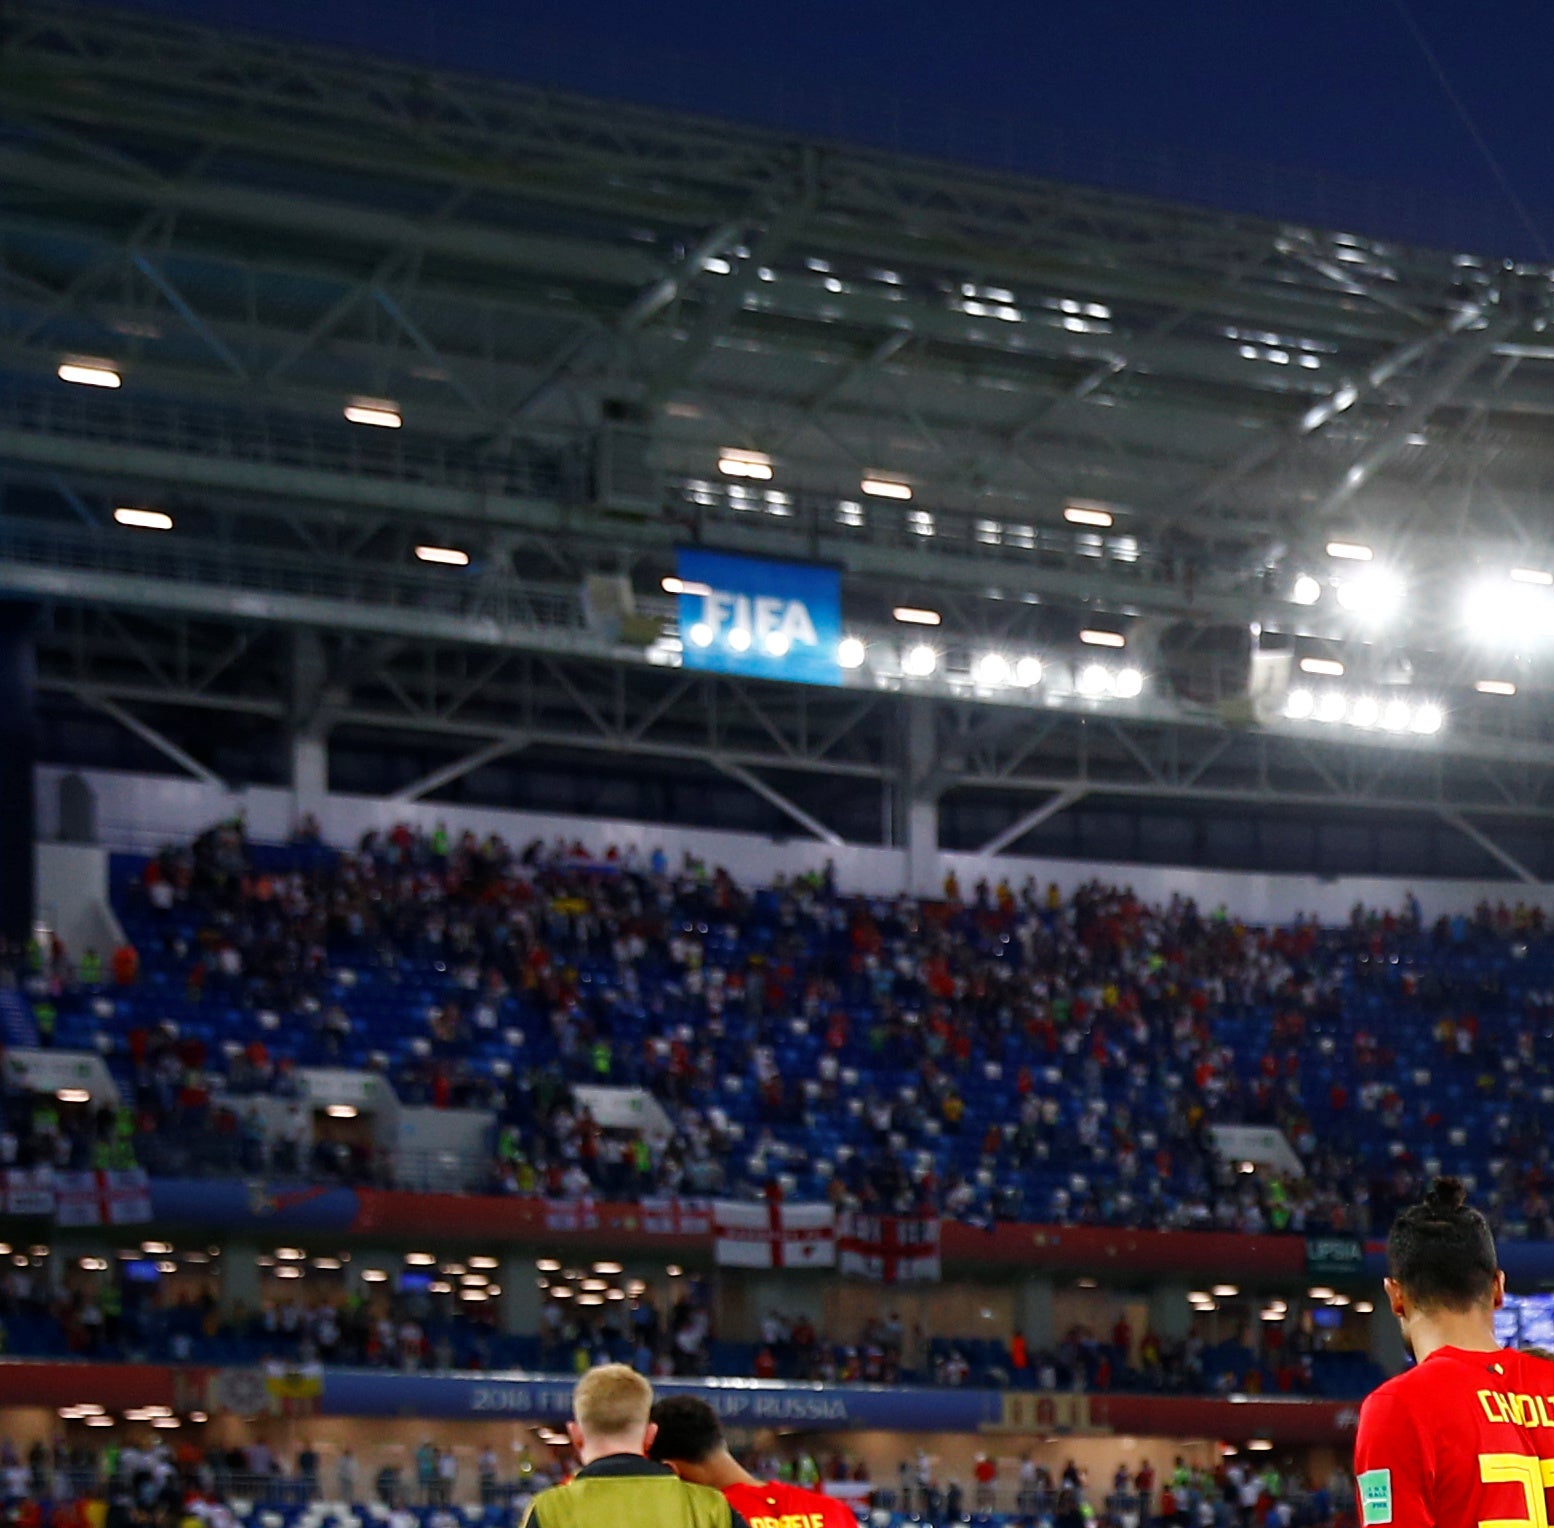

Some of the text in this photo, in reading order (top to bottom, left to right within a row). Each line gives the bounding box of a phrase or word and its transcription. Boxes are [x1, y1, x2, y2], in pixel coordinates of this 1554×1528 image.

[702, 589, 818, 647] FIFA
[470, 1388, 532, 1413] 2018
[755, 1397, 848, 1421] RUSSIA
